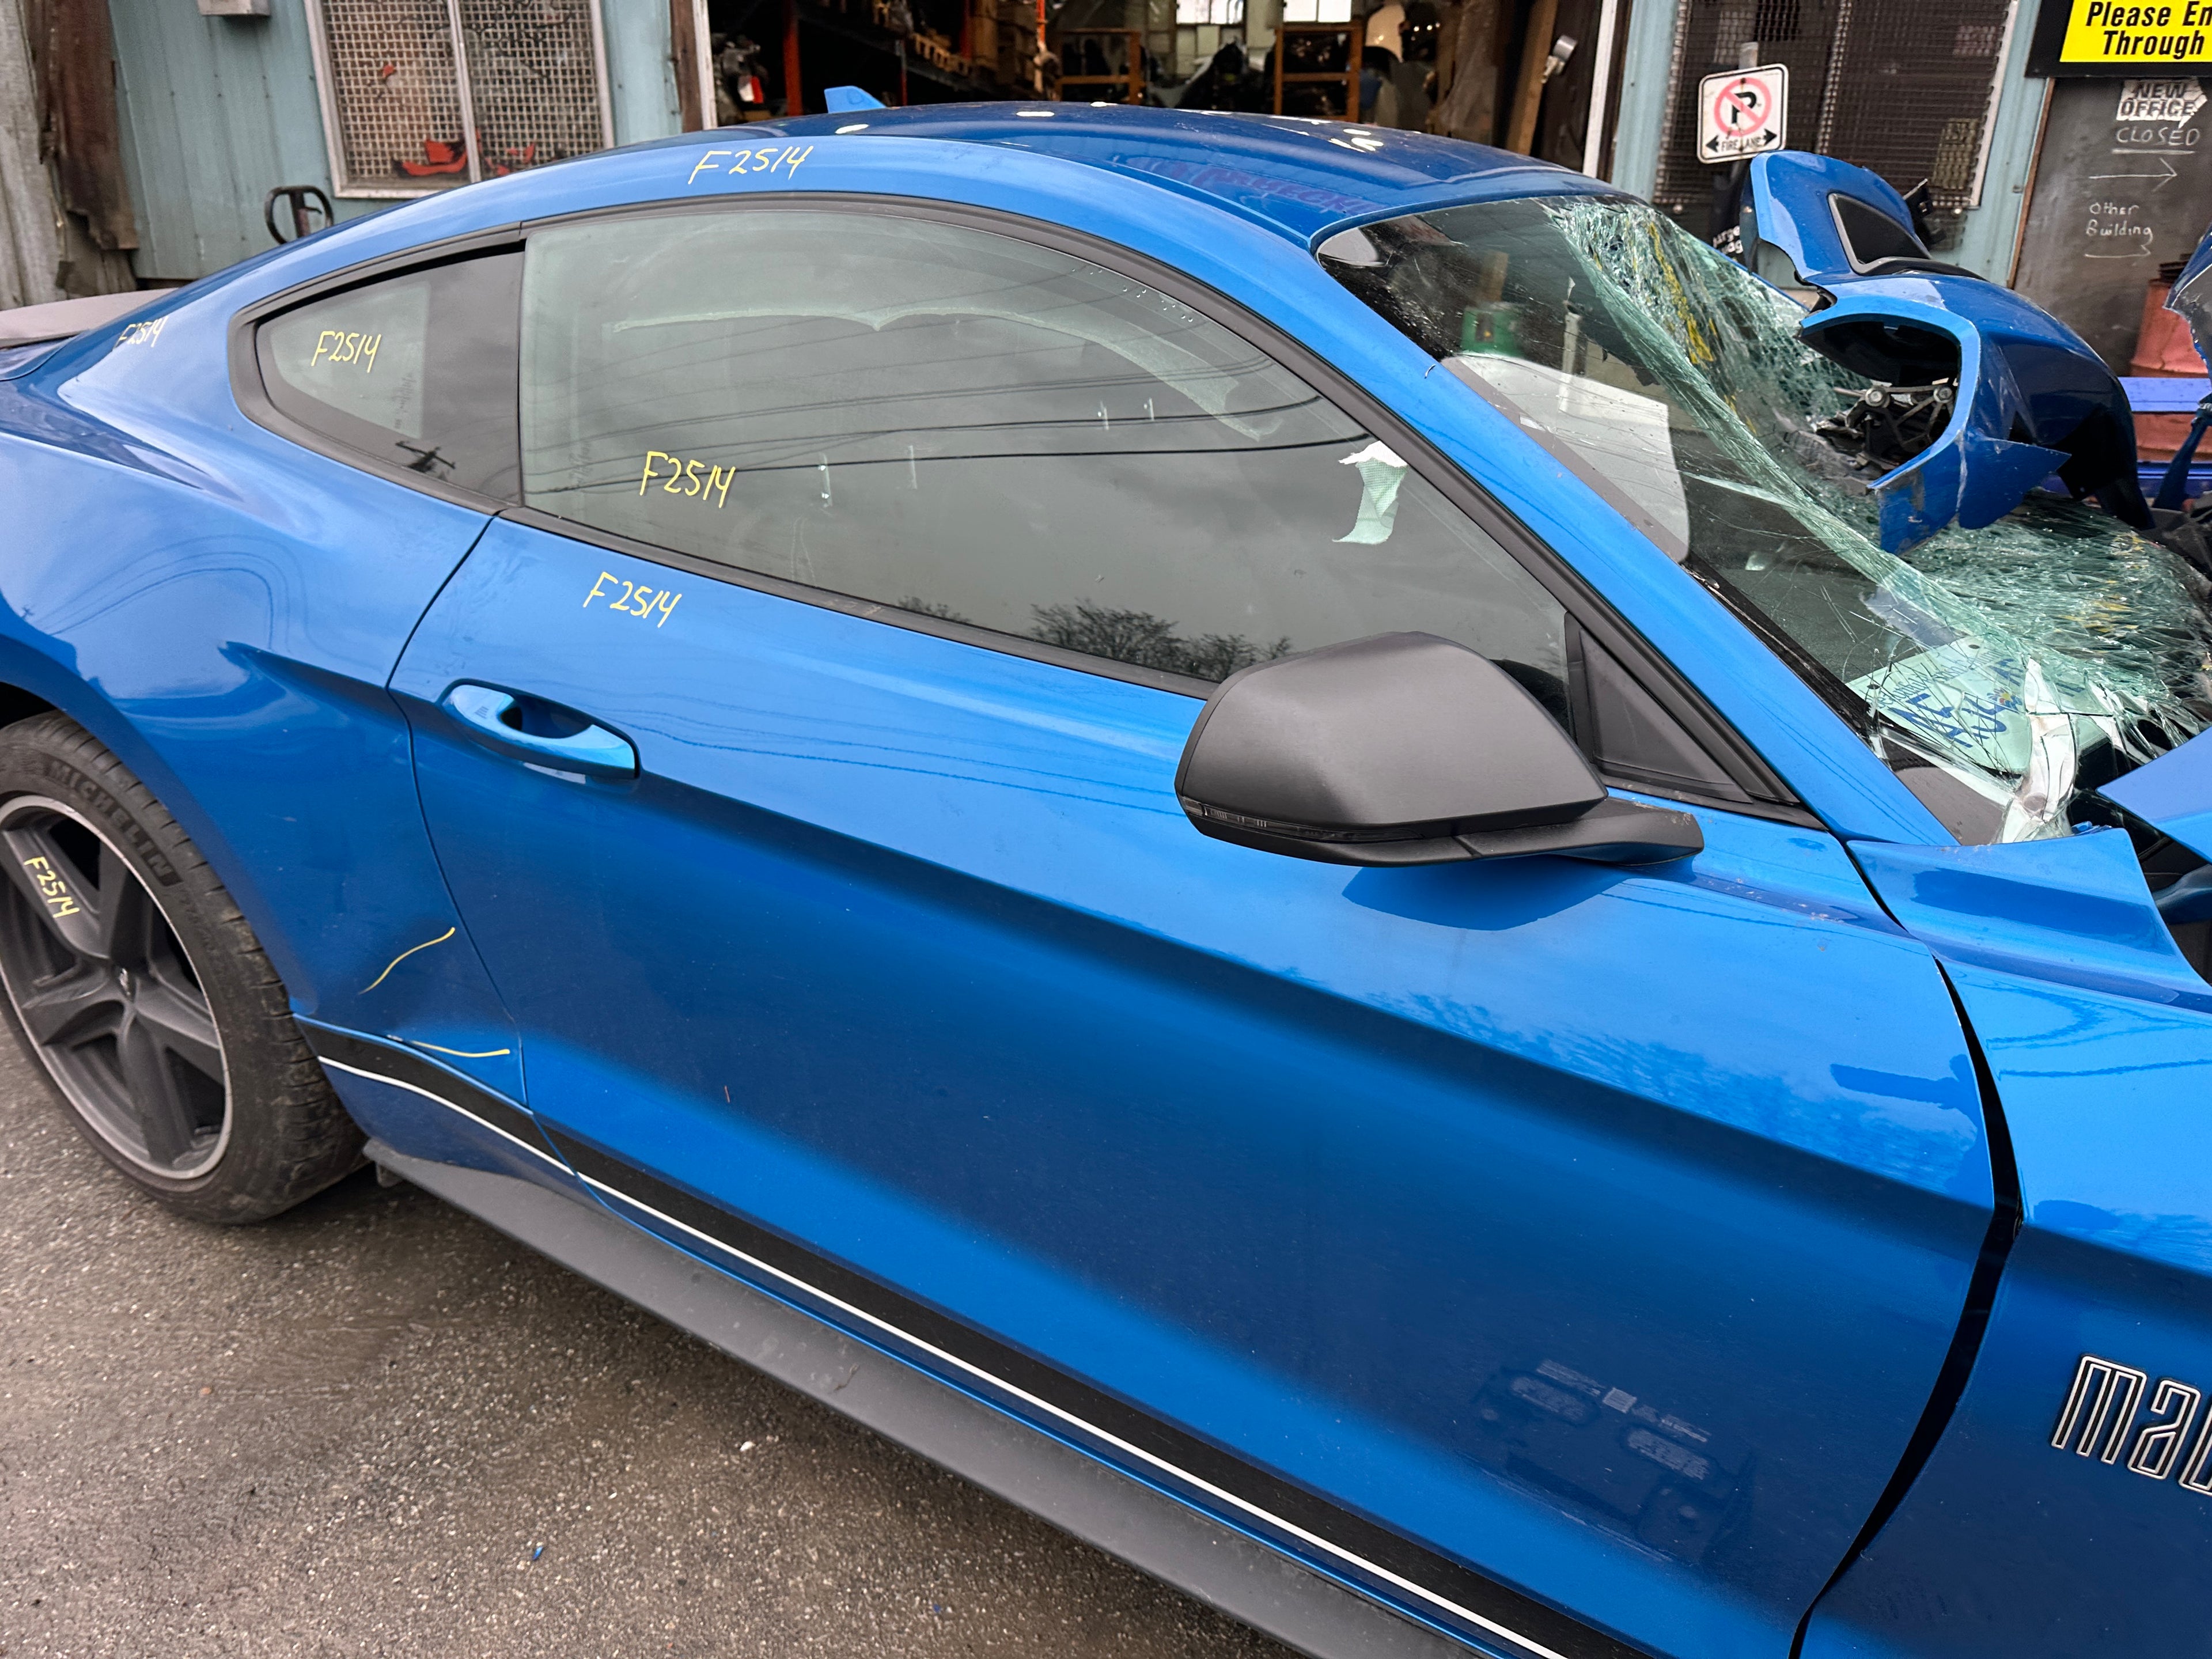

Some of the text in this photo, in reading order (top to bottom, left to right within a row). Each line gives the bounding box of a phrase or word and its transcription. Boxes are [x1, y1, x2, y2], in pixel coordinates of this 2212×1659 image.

[2086, 2, 2171, 26] Please
[2103, 30, 2205, 59] Through
[2134, 82, 2184, 99] NEW
[1721, 139, 1738, 151] FIRE
[2116, 127, 2200, 146] CLOSED
[688, 146, 813, 184] F2514
[2086, 219, 2153, 246] Building
[112, 316, 169, 350] F2514
[311, 331, 381, 373] F2514
[639, 451, 736, 508] F2514
[582, 571, 682, 628] F2514
[48, 759, 173, 878] MICHELIN
[23, 856, 80, 918] F2514
